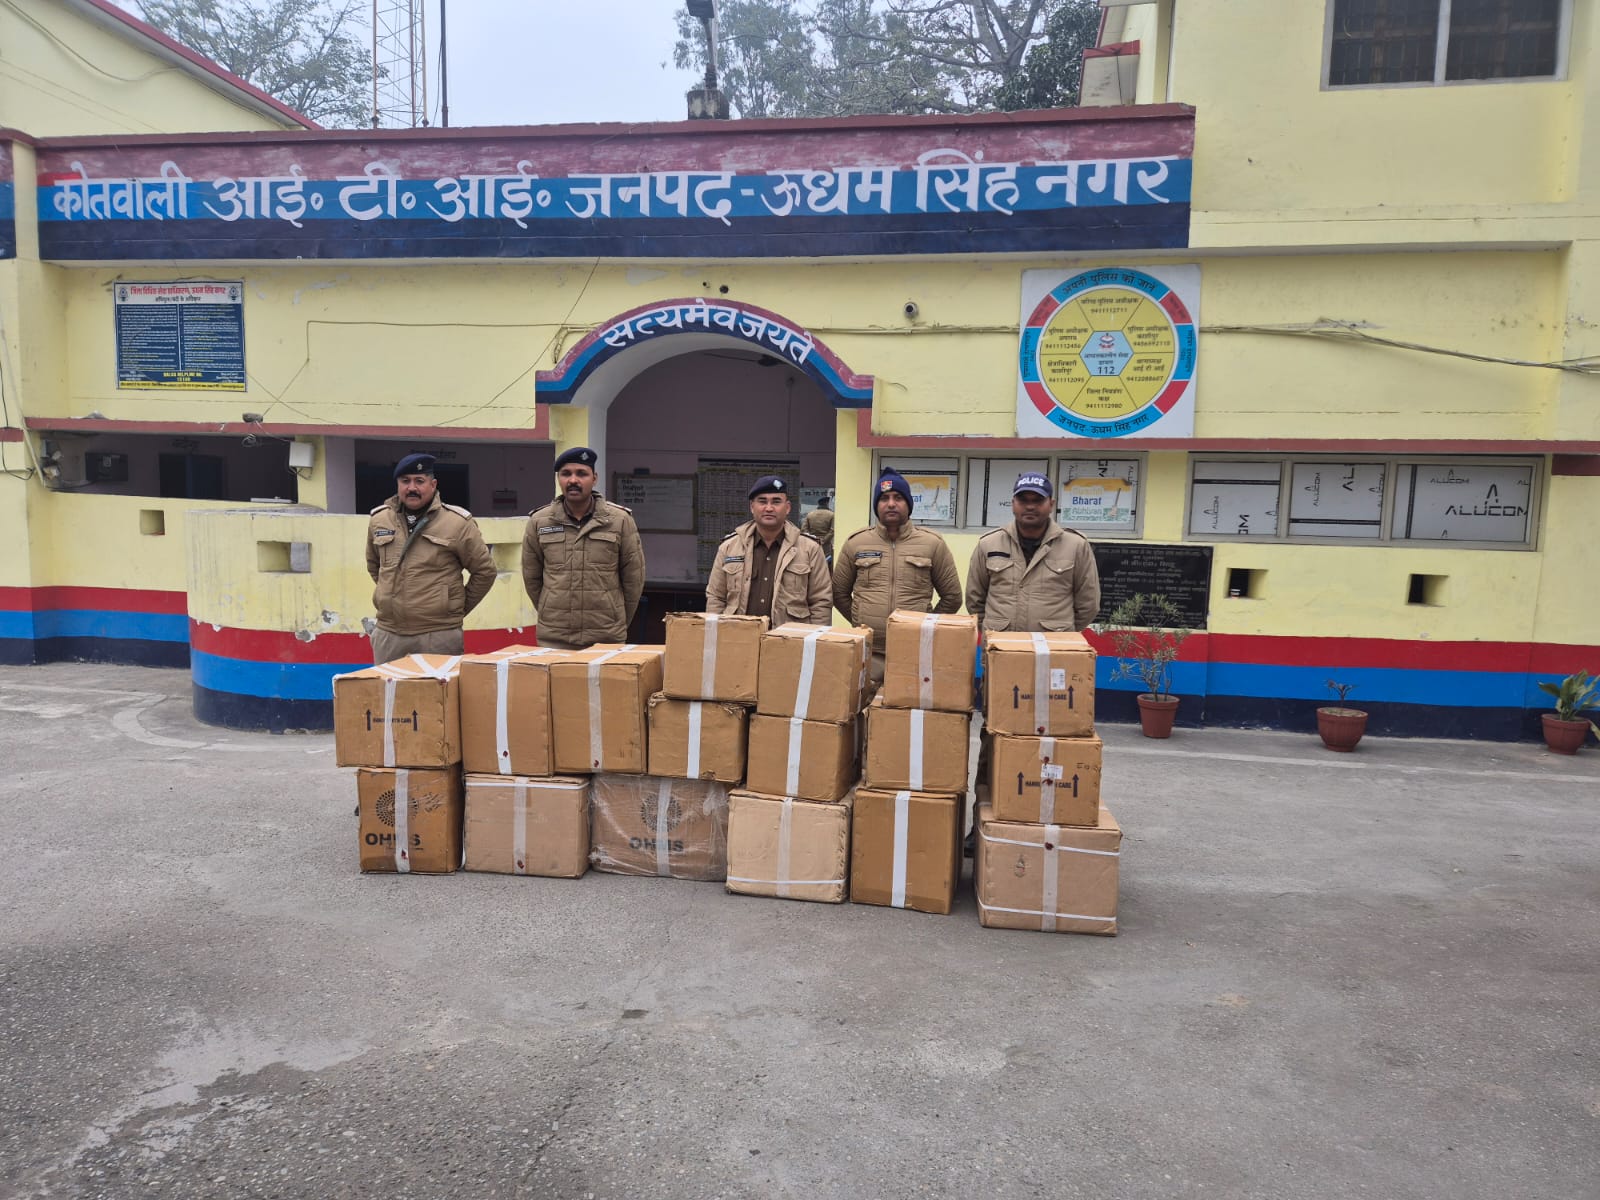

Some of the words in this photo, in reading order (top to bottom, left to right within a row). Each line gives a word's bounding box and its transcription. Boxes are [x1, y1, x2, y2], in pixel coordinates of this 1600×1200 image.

[53, 160, 193, 221] कोतवाली
[914, 148, 1020, 216] सिंह
[1035, 154, 1181, 205] नगर
[1098, 366, 1115, 374] 112
[1445, 505, 1529, 517] ALUCOM
[365, 833, 421, 846] OHS
[629, 837, 684, 852] OHS
